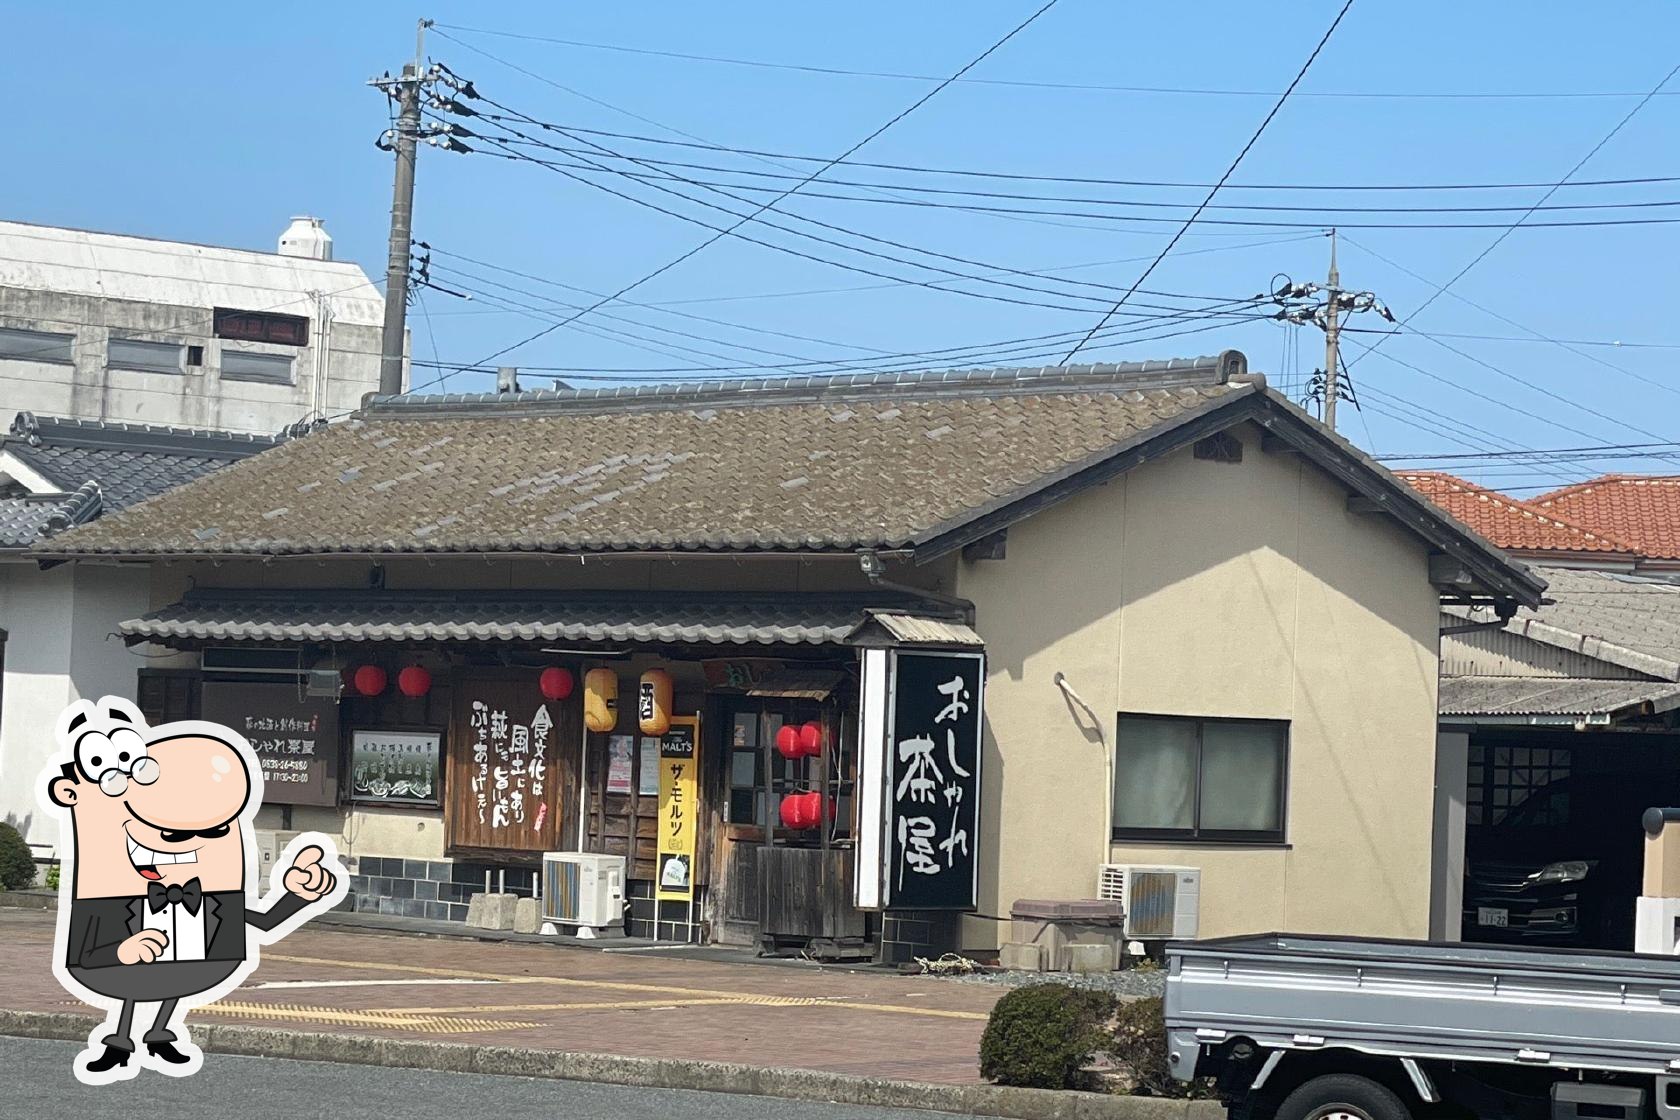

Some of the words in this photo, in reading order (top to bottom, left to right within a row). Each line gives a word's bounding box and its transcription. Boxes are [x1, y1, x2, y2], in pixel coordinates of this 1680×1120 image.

[509, 724, 529, 824] 風土にあり
[528, 703, 554, 796] 食文化は
[661, 740, 693, 753] MALT'S
[934, 675, 969, 868] おしゃれ
[669, 764, 685, 837] ザ・モルツ
[897, 733, 944, 892] 茶屋
